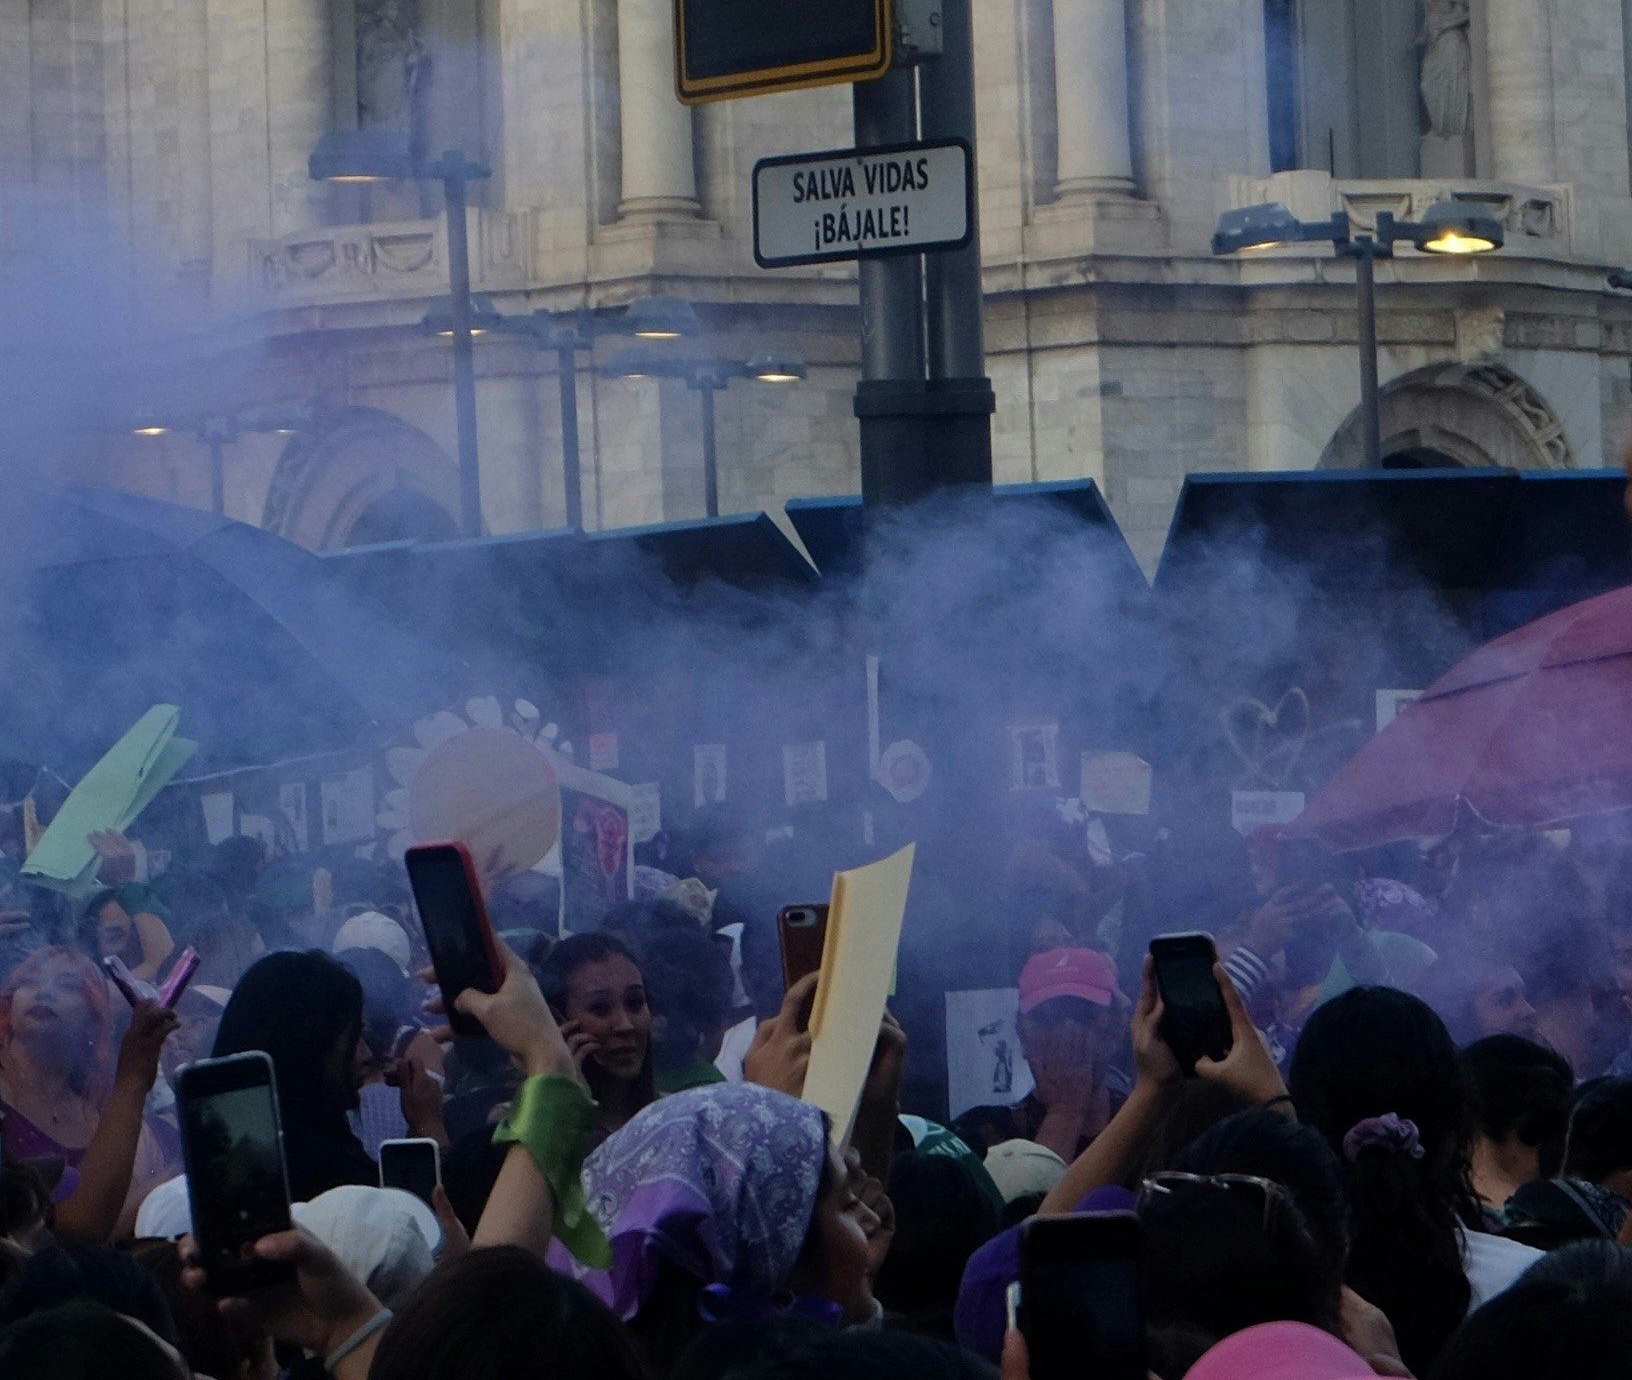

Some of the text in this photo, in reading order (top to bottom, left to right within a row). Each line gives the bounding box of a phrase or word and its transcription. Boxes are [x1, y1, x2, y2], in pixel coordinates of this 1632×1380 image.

[793, 157, 929, 203] SALVA VIDAS
[815, 202, 910, 251] ¡BÁJALE!
